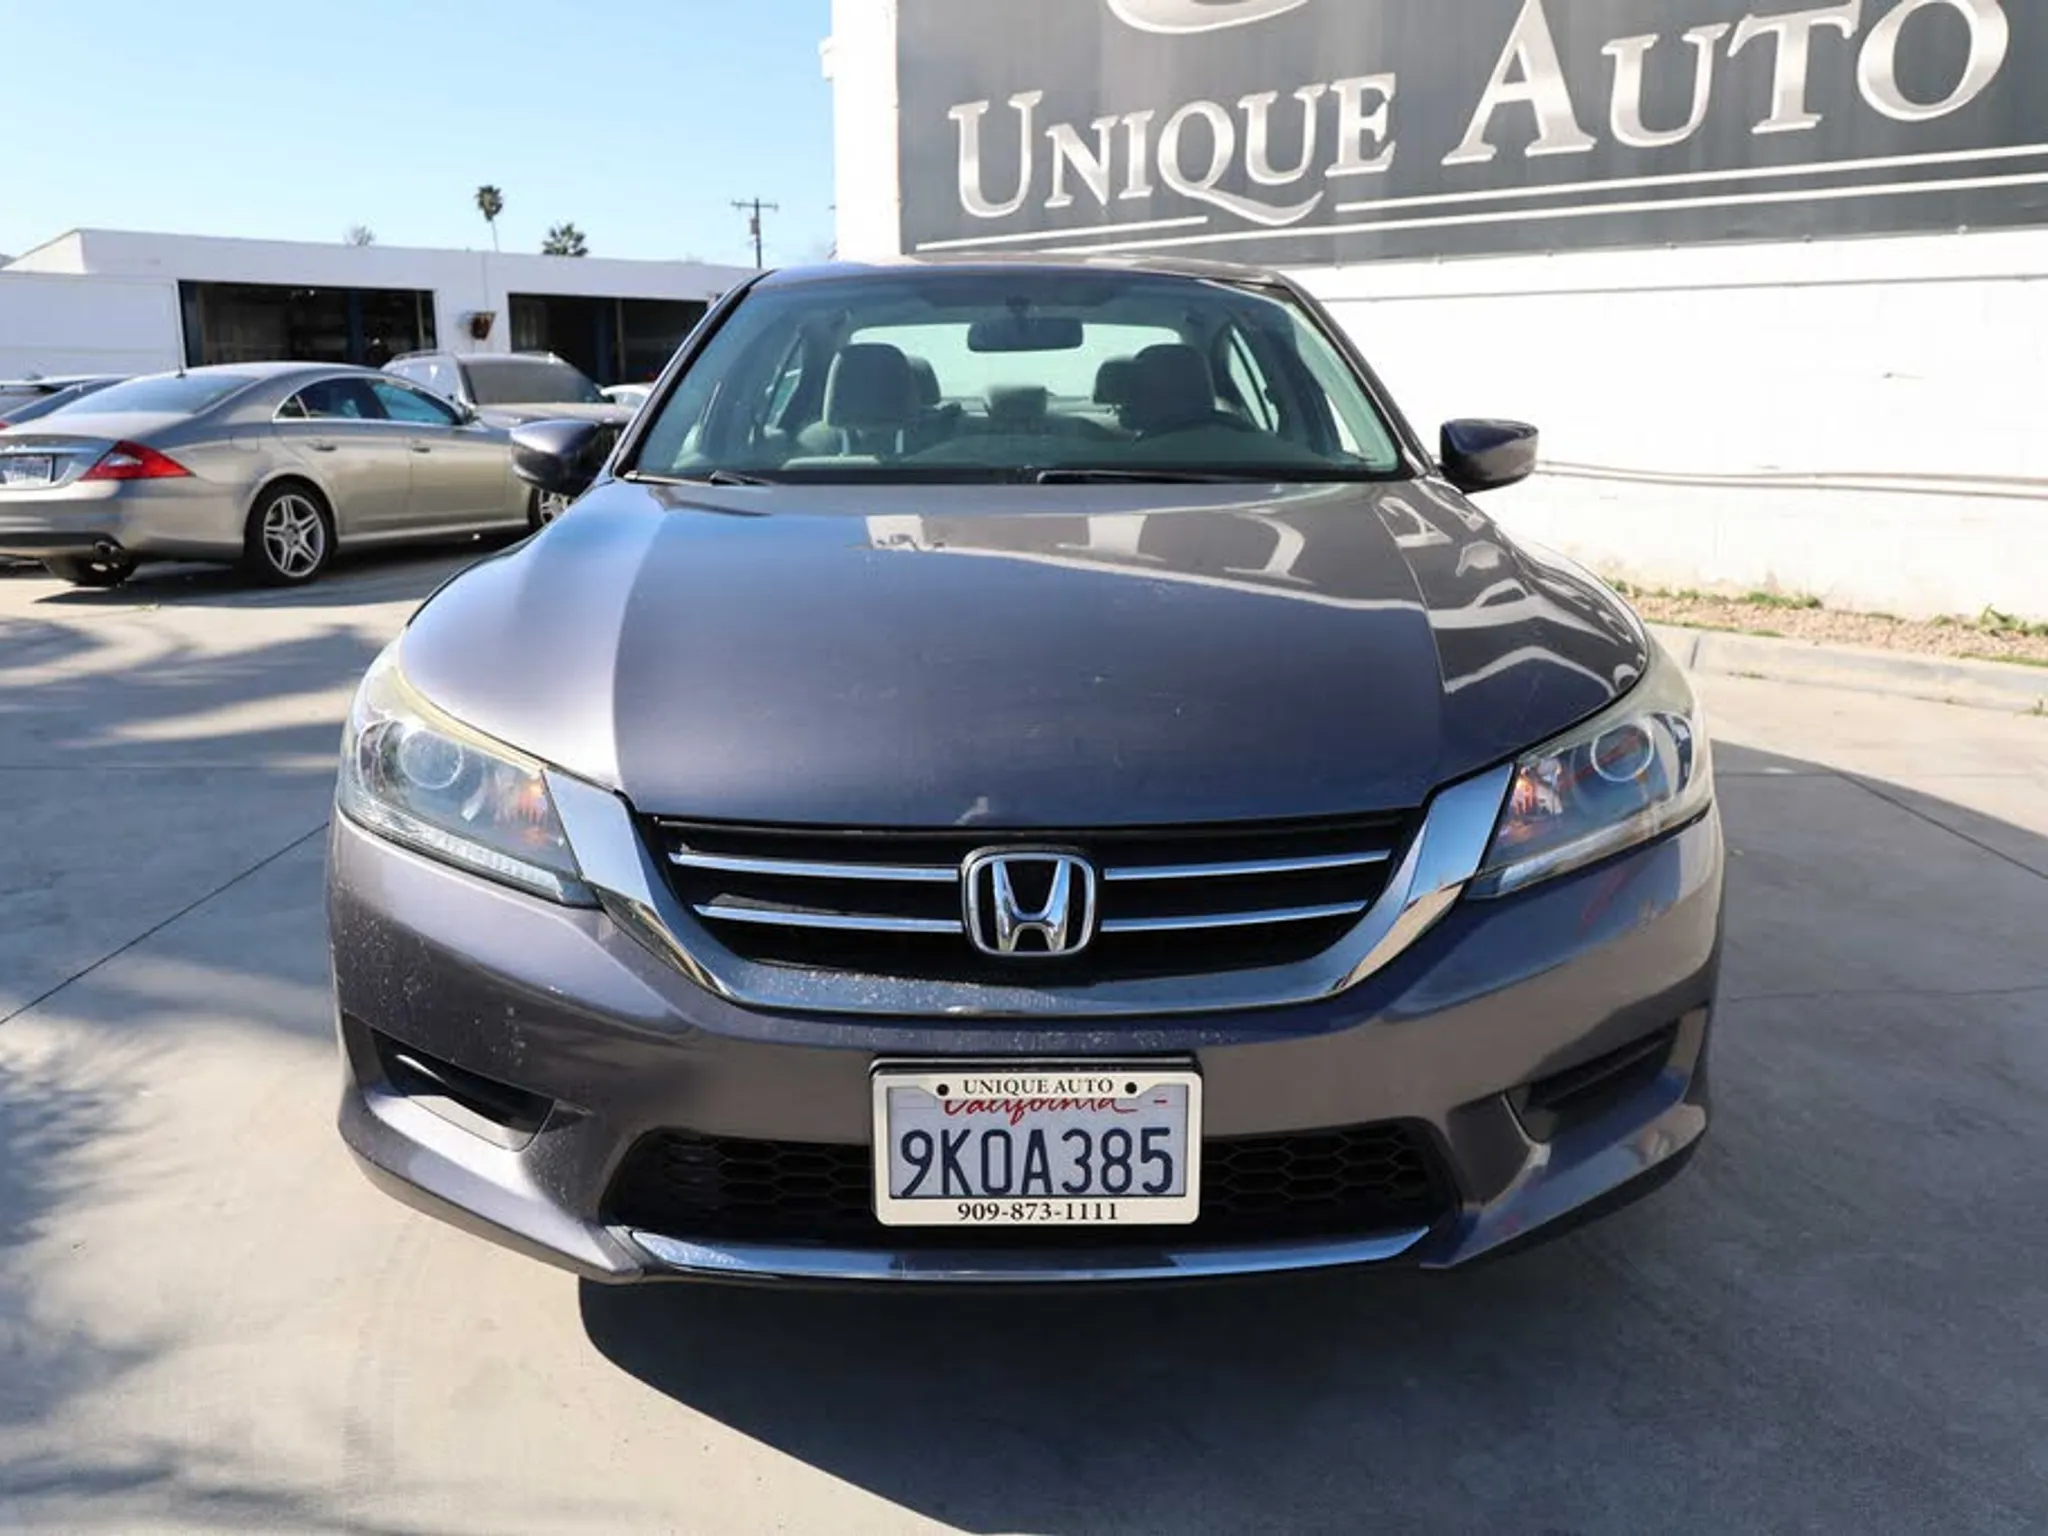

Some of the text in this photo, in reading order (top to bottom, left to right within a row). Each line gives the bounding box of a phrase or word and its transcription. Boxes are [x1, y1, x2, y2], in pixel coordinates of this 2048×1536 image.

[948, 0, 2010, 226] UNIQUE AUTO
[963, 1079, 1114, 1096] UNIQUE AUTO
[957, 1202, 1118, 1221] 909-873-1111
